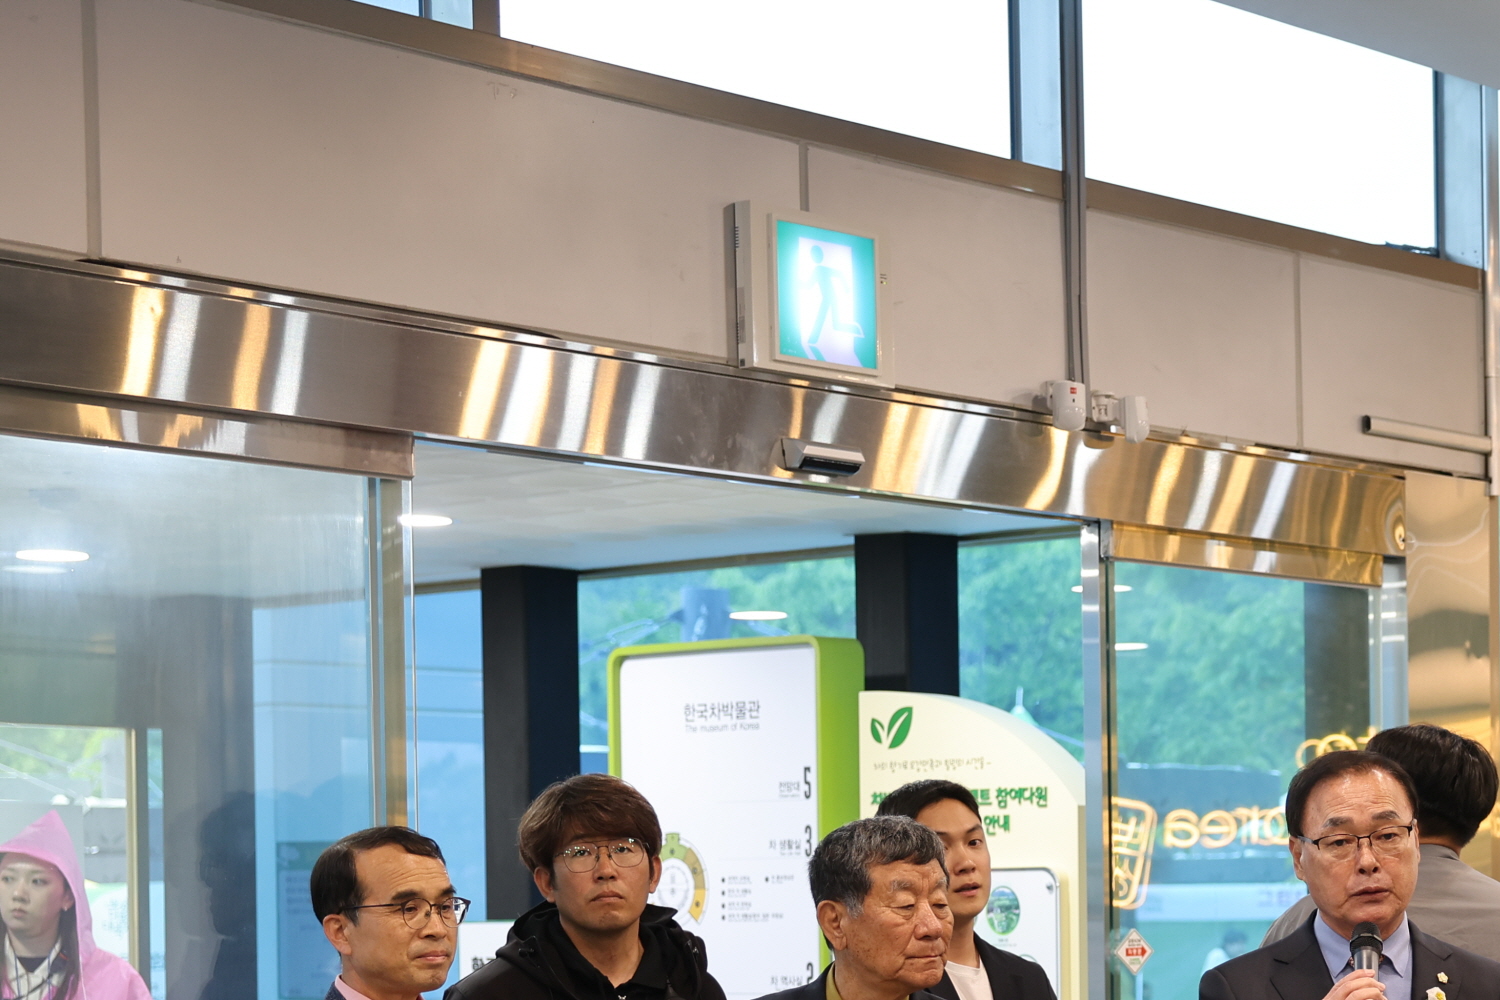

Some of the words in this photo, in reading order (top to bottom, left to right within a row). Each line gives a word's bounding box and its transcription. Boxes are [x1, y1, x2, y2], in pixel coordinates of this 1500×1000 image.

[684, 700, 760, 722] 한국차박물관
[803, 766, 811, 799] 5
[996, 786, 1048, 809] 참여다원
[984, 814, 1010, 835] 안내
[804, 824, 812, 857] 3
[806, 962, 814, 984] 2
